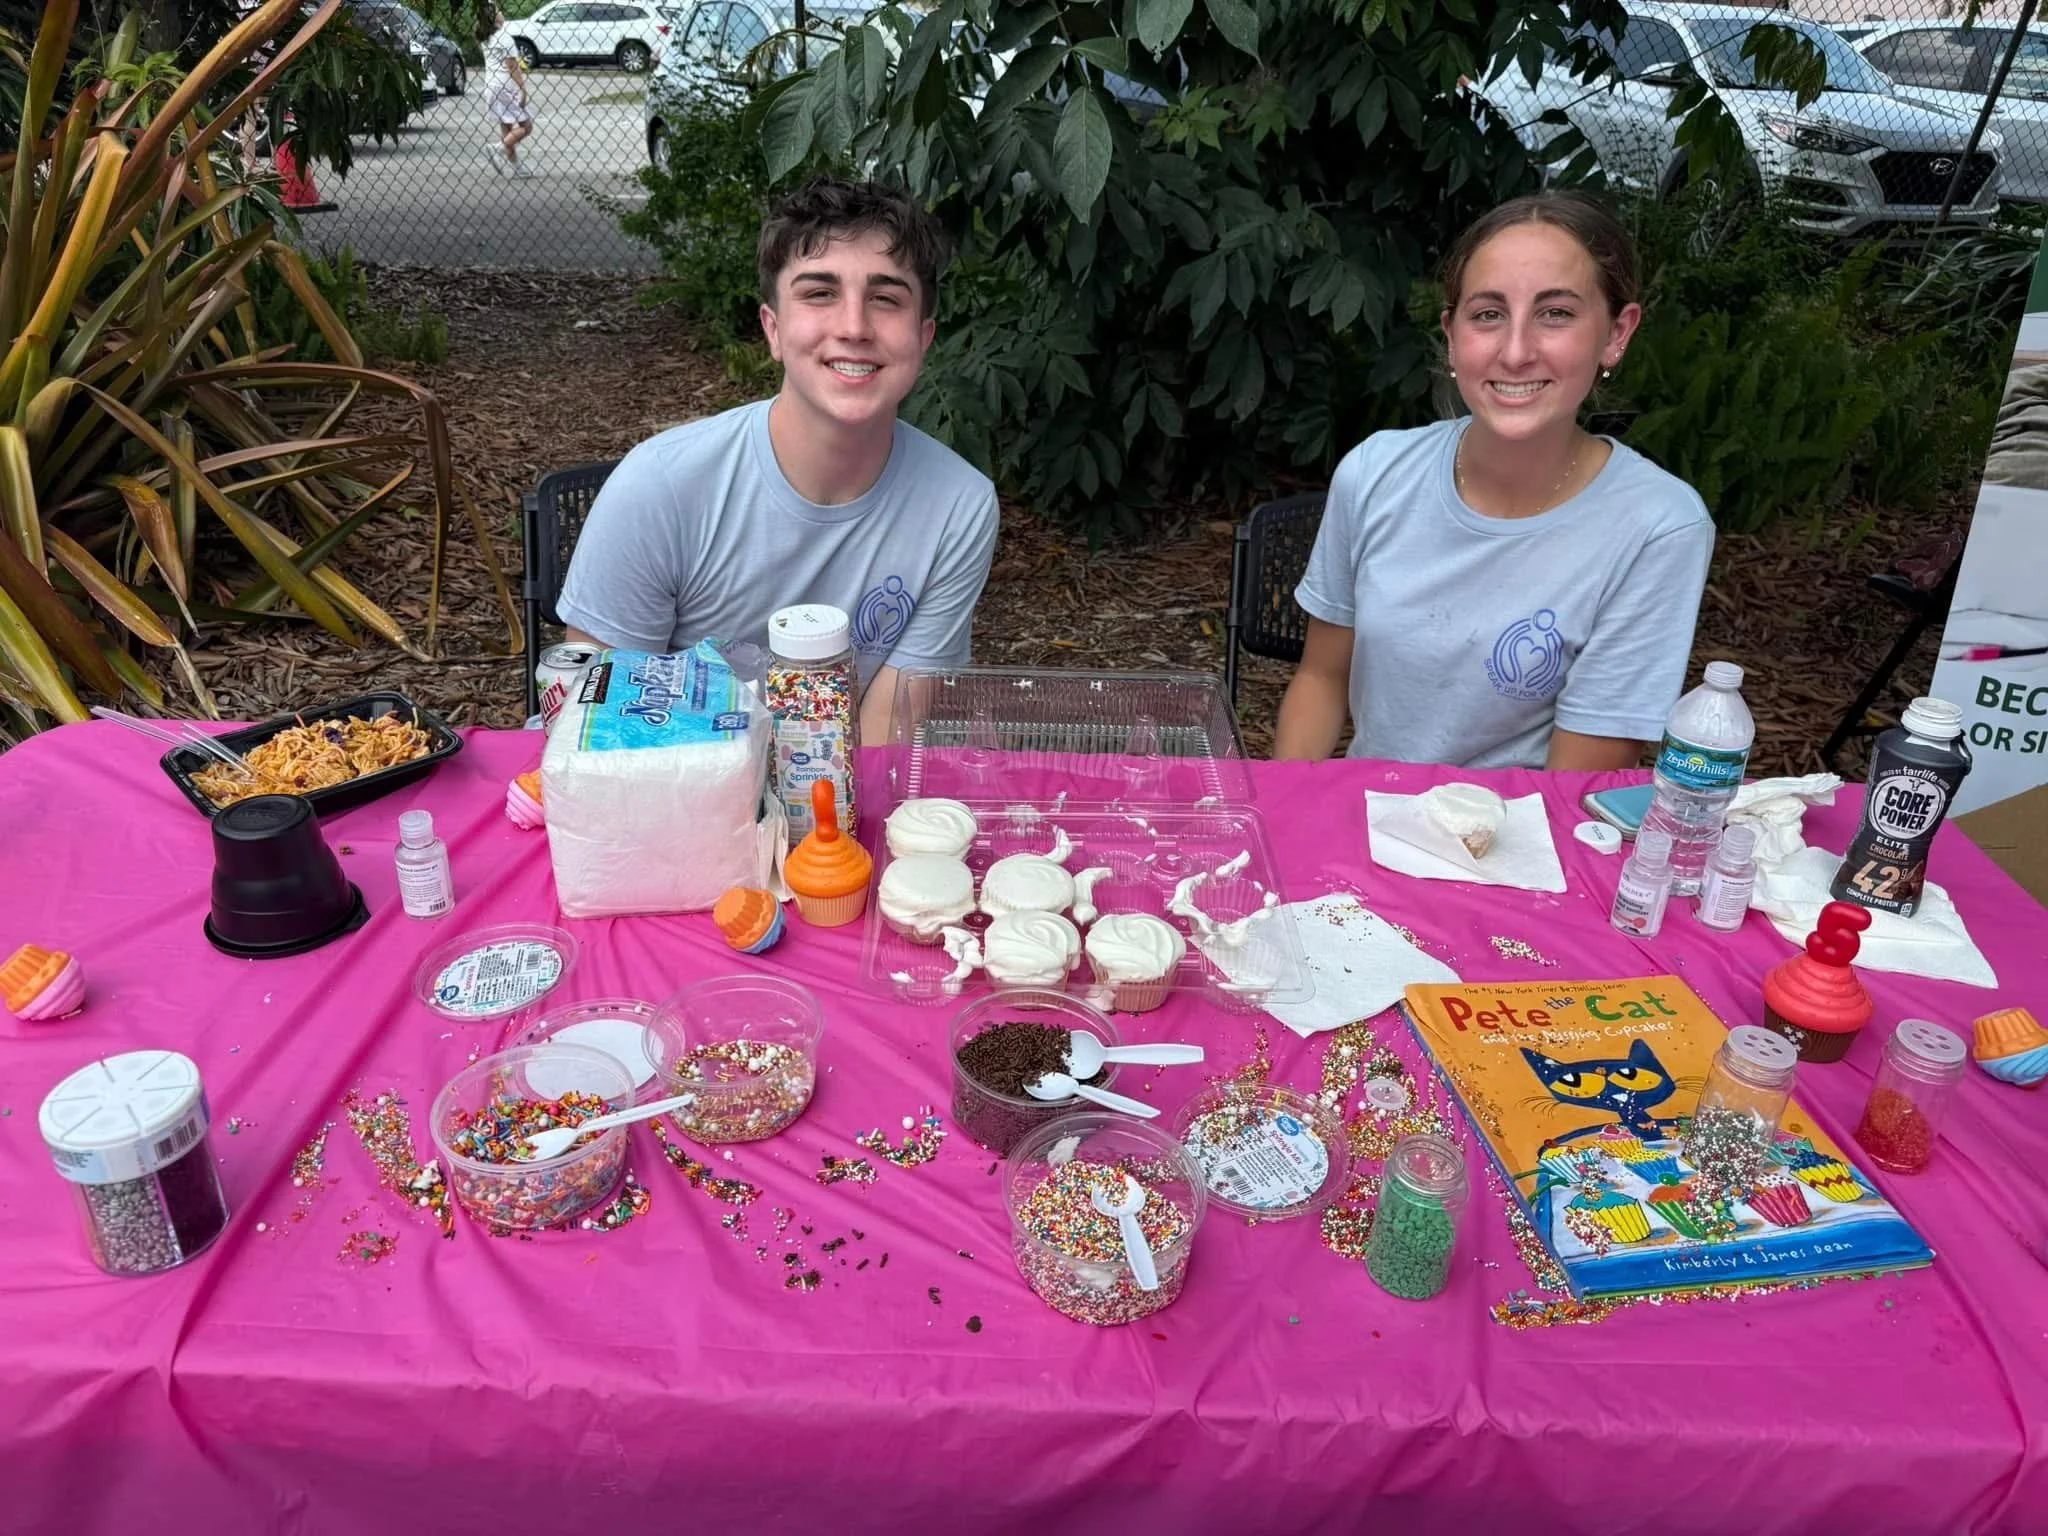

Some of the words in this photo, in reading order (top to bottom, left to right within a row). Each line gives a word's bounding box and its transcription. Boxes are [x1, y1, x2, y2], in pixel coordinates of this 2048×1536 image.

[1484, 658, 1502, 691] SPEAK
[1504, 686, 1517, 694] UP
[1975, 675, 2048, 716] BEC
[1970, 722, 2014, 751] OR
[1666, 751, 1727, 775] Zephyrhills
[1903, 764, 1938, 782] fairlife
[1885, 786, 1936, 815] CORE
[1878, 805, 1927, 830] POWER
[1870, 843, 1909, 860] CHOCOLATE
[1876, 835, 1910, 849] ELITE
[1846, 887, 1874, 904] COMPLETE
[1874, 897, 1899, 908] PROTEIN
[1495, 987, 1513, 995] New
[1536, 985, 1557, 993] Times
[1440, 996, 1552, 1032] Pete
[1544, 995, 1576, 1010] the
[1584, 991, 1678, 1021] Cat
[1541, 1029, 1601, 1044] Missing
[1604, 1021, 1674, 1038] Cupcakes
[1664, 1255, 1736, 1271] Kimberly
[1743, 1253, 1756, 1264] &
[1761, 1248, 1806, 1263] James
[1814, 1242, 1853, 1255] Dean
